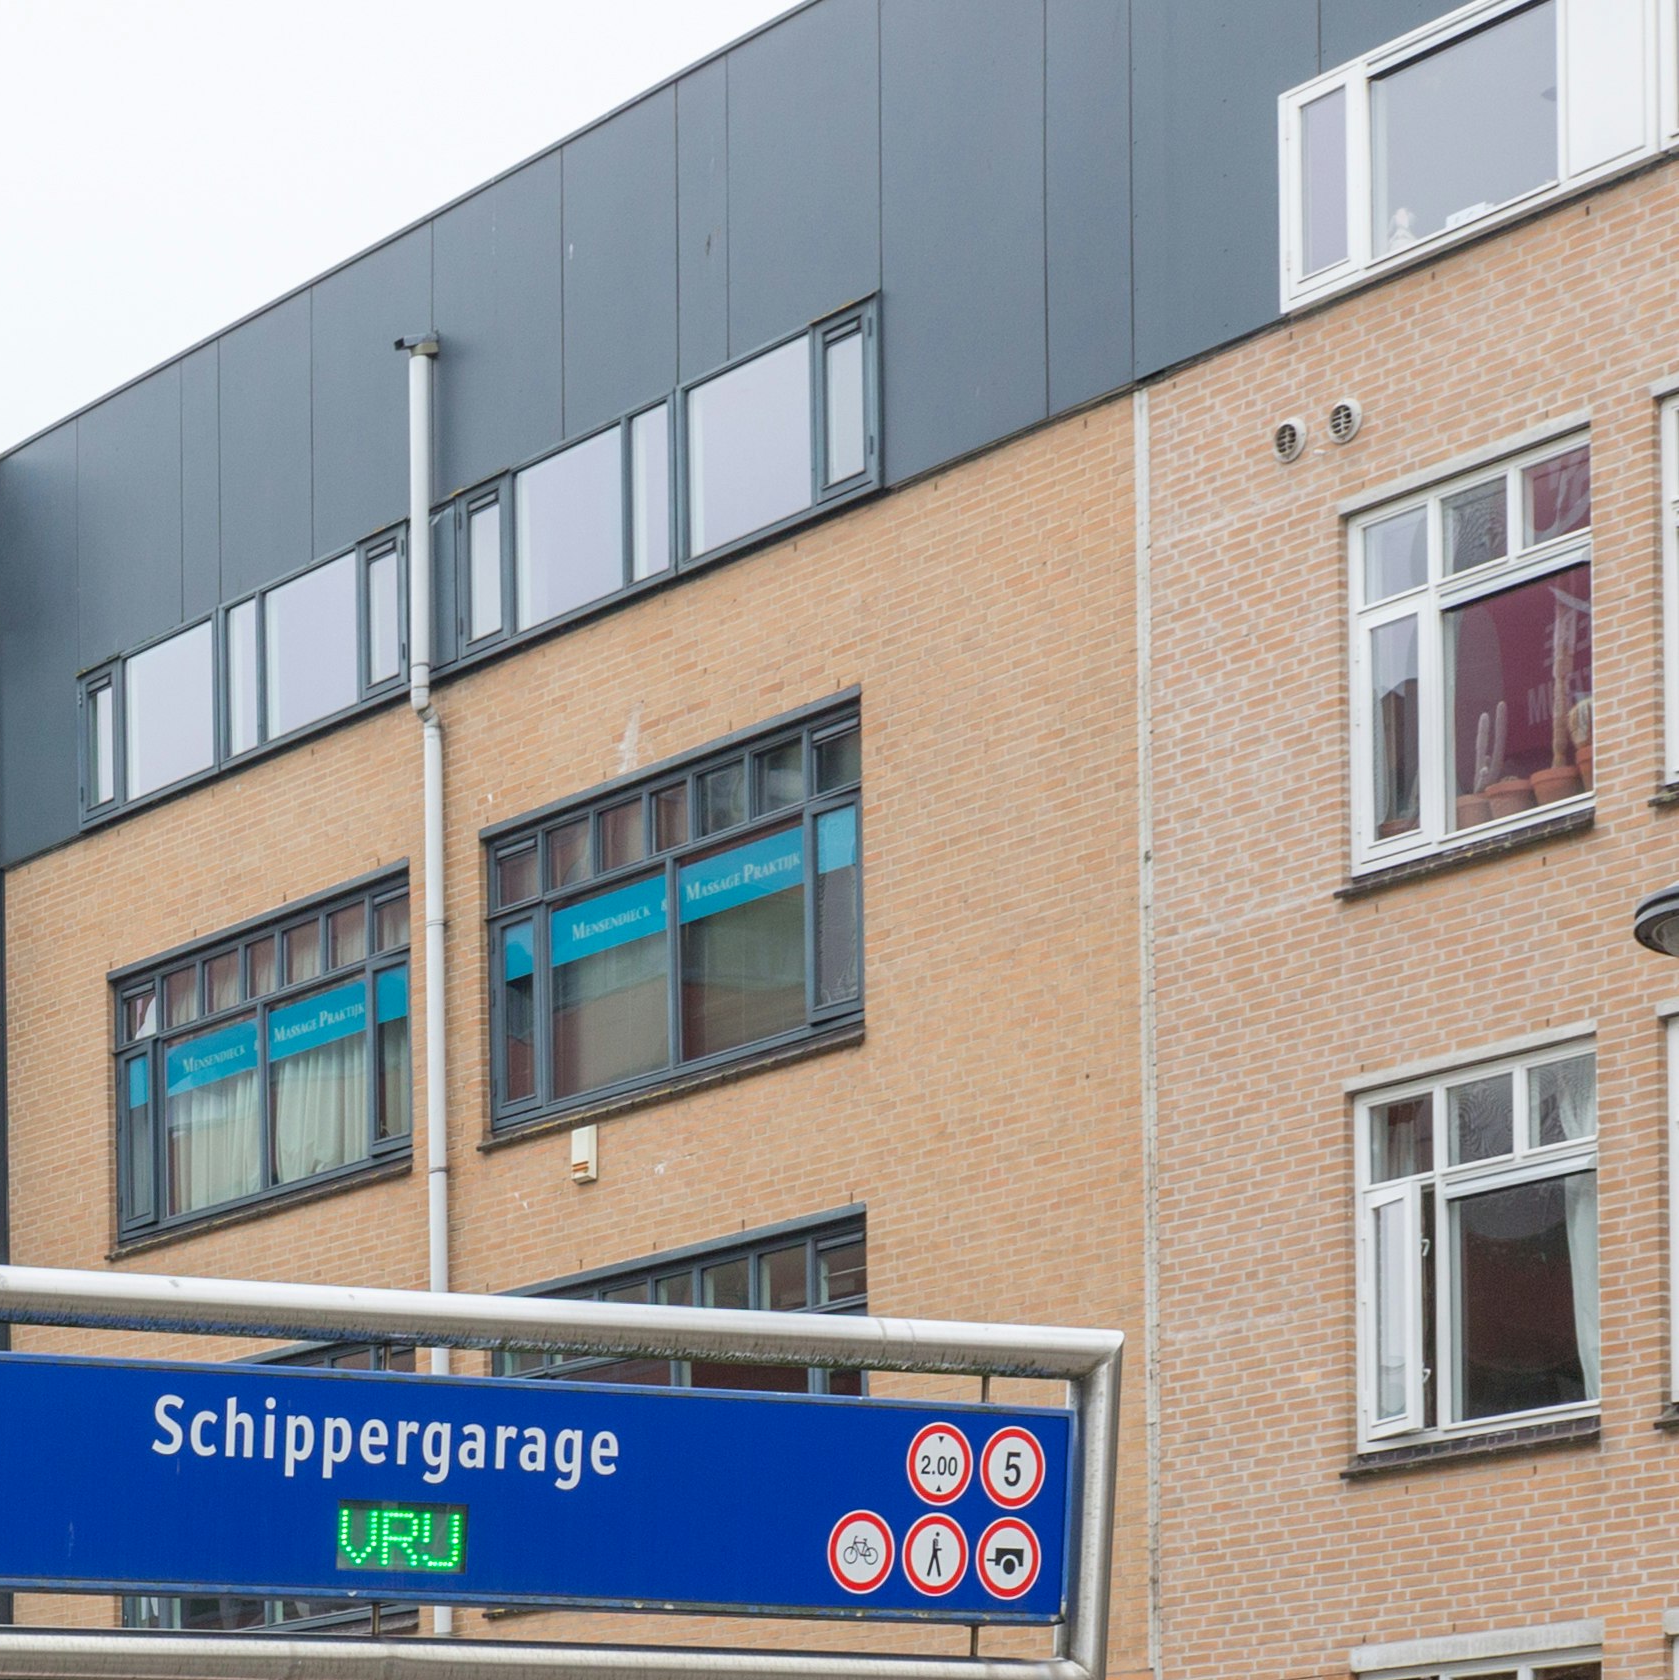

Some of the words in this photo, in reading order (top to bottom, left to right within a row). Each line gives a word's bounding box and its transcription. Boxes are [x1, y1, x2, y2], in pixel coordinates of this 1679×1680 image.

[685, 880, 741, 904] MASSAGE
[743, 852, 802, 884] PRAKTIJK
[572, 906, 651, 942] MENSENDIECK
[273, 1018, 318, 1043] MASSAGE
[319, 1002, 366, 1028] PRAKTIJK
[182, 1044, 246, 1073] MENSENDIECK
[152, 1394, 619, 1490] Schippergarage
[921, 1455, 958, 1477] 2.00
[1003, 1451, 1022, 1487] 5
